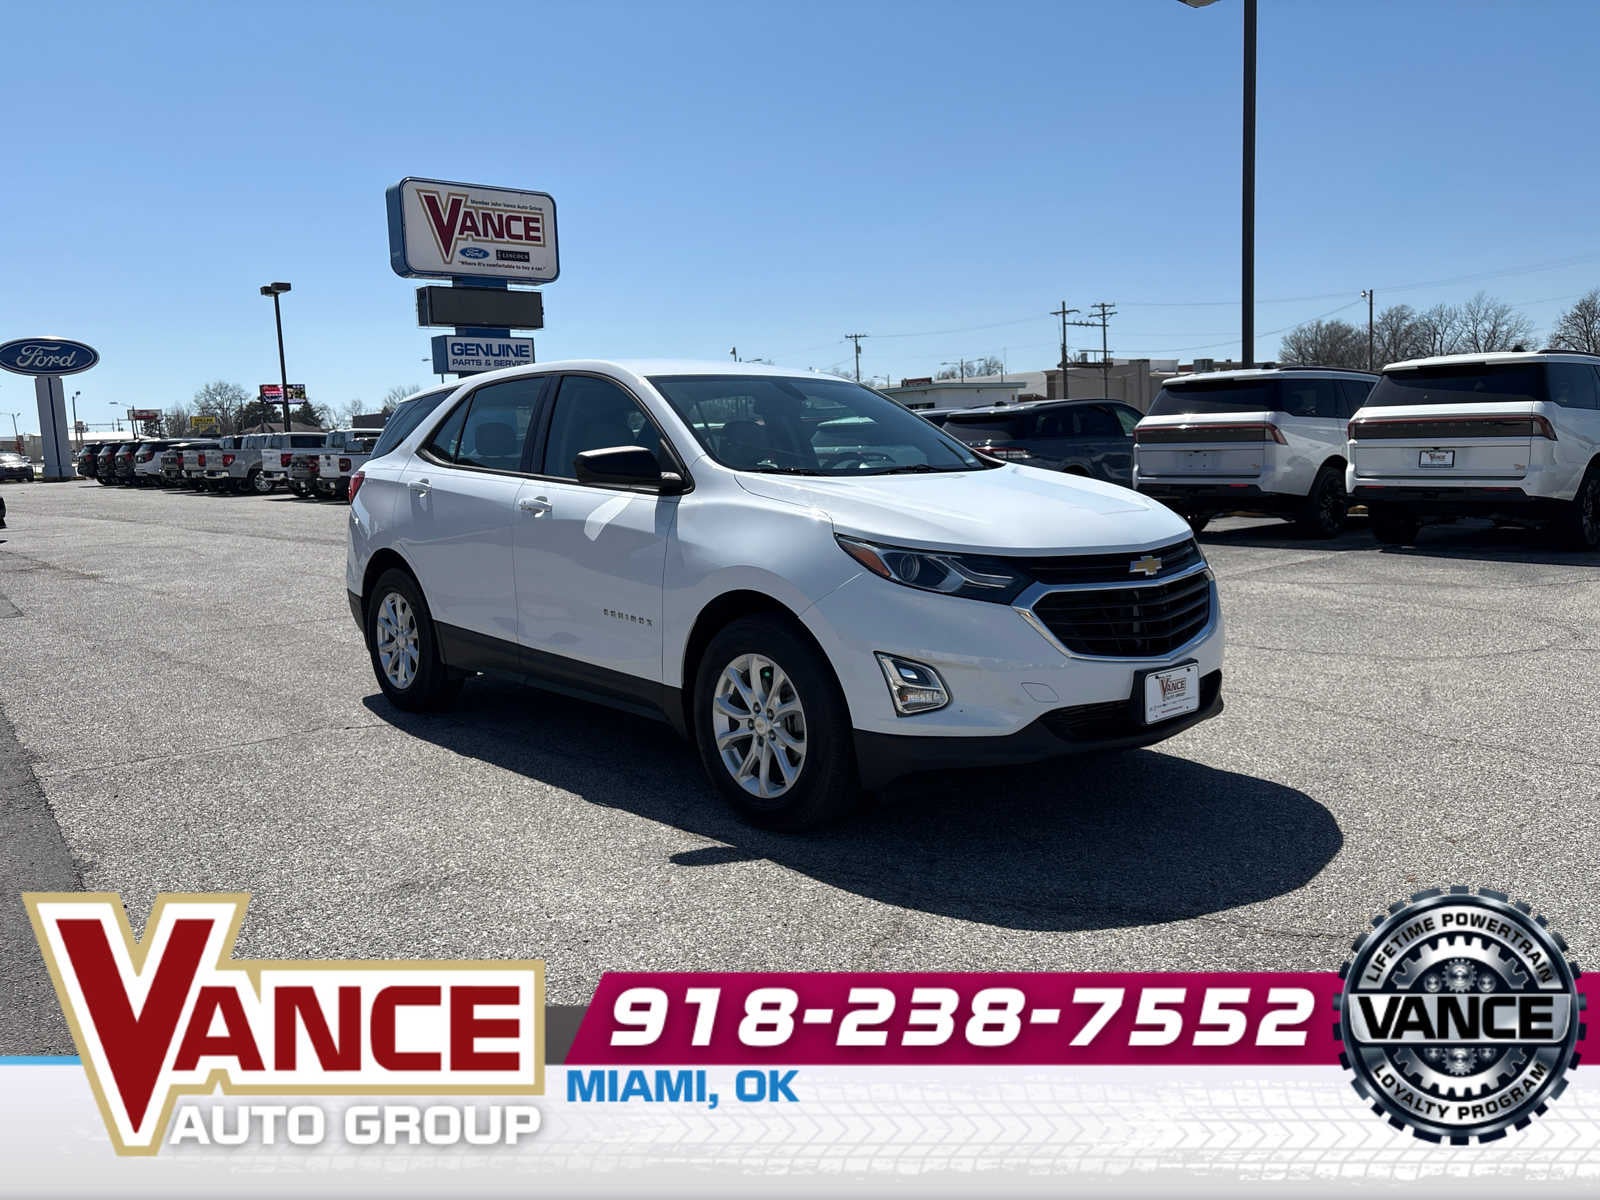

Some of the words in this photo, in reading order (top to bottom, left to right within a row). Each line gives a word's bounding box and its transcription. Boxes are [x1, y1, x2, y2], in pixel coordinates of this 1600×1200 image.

[422, 193, 542, 260] VANCE
[16, 344, 77, 367] Ford
[451, 342, 530, 358] GENUINE
